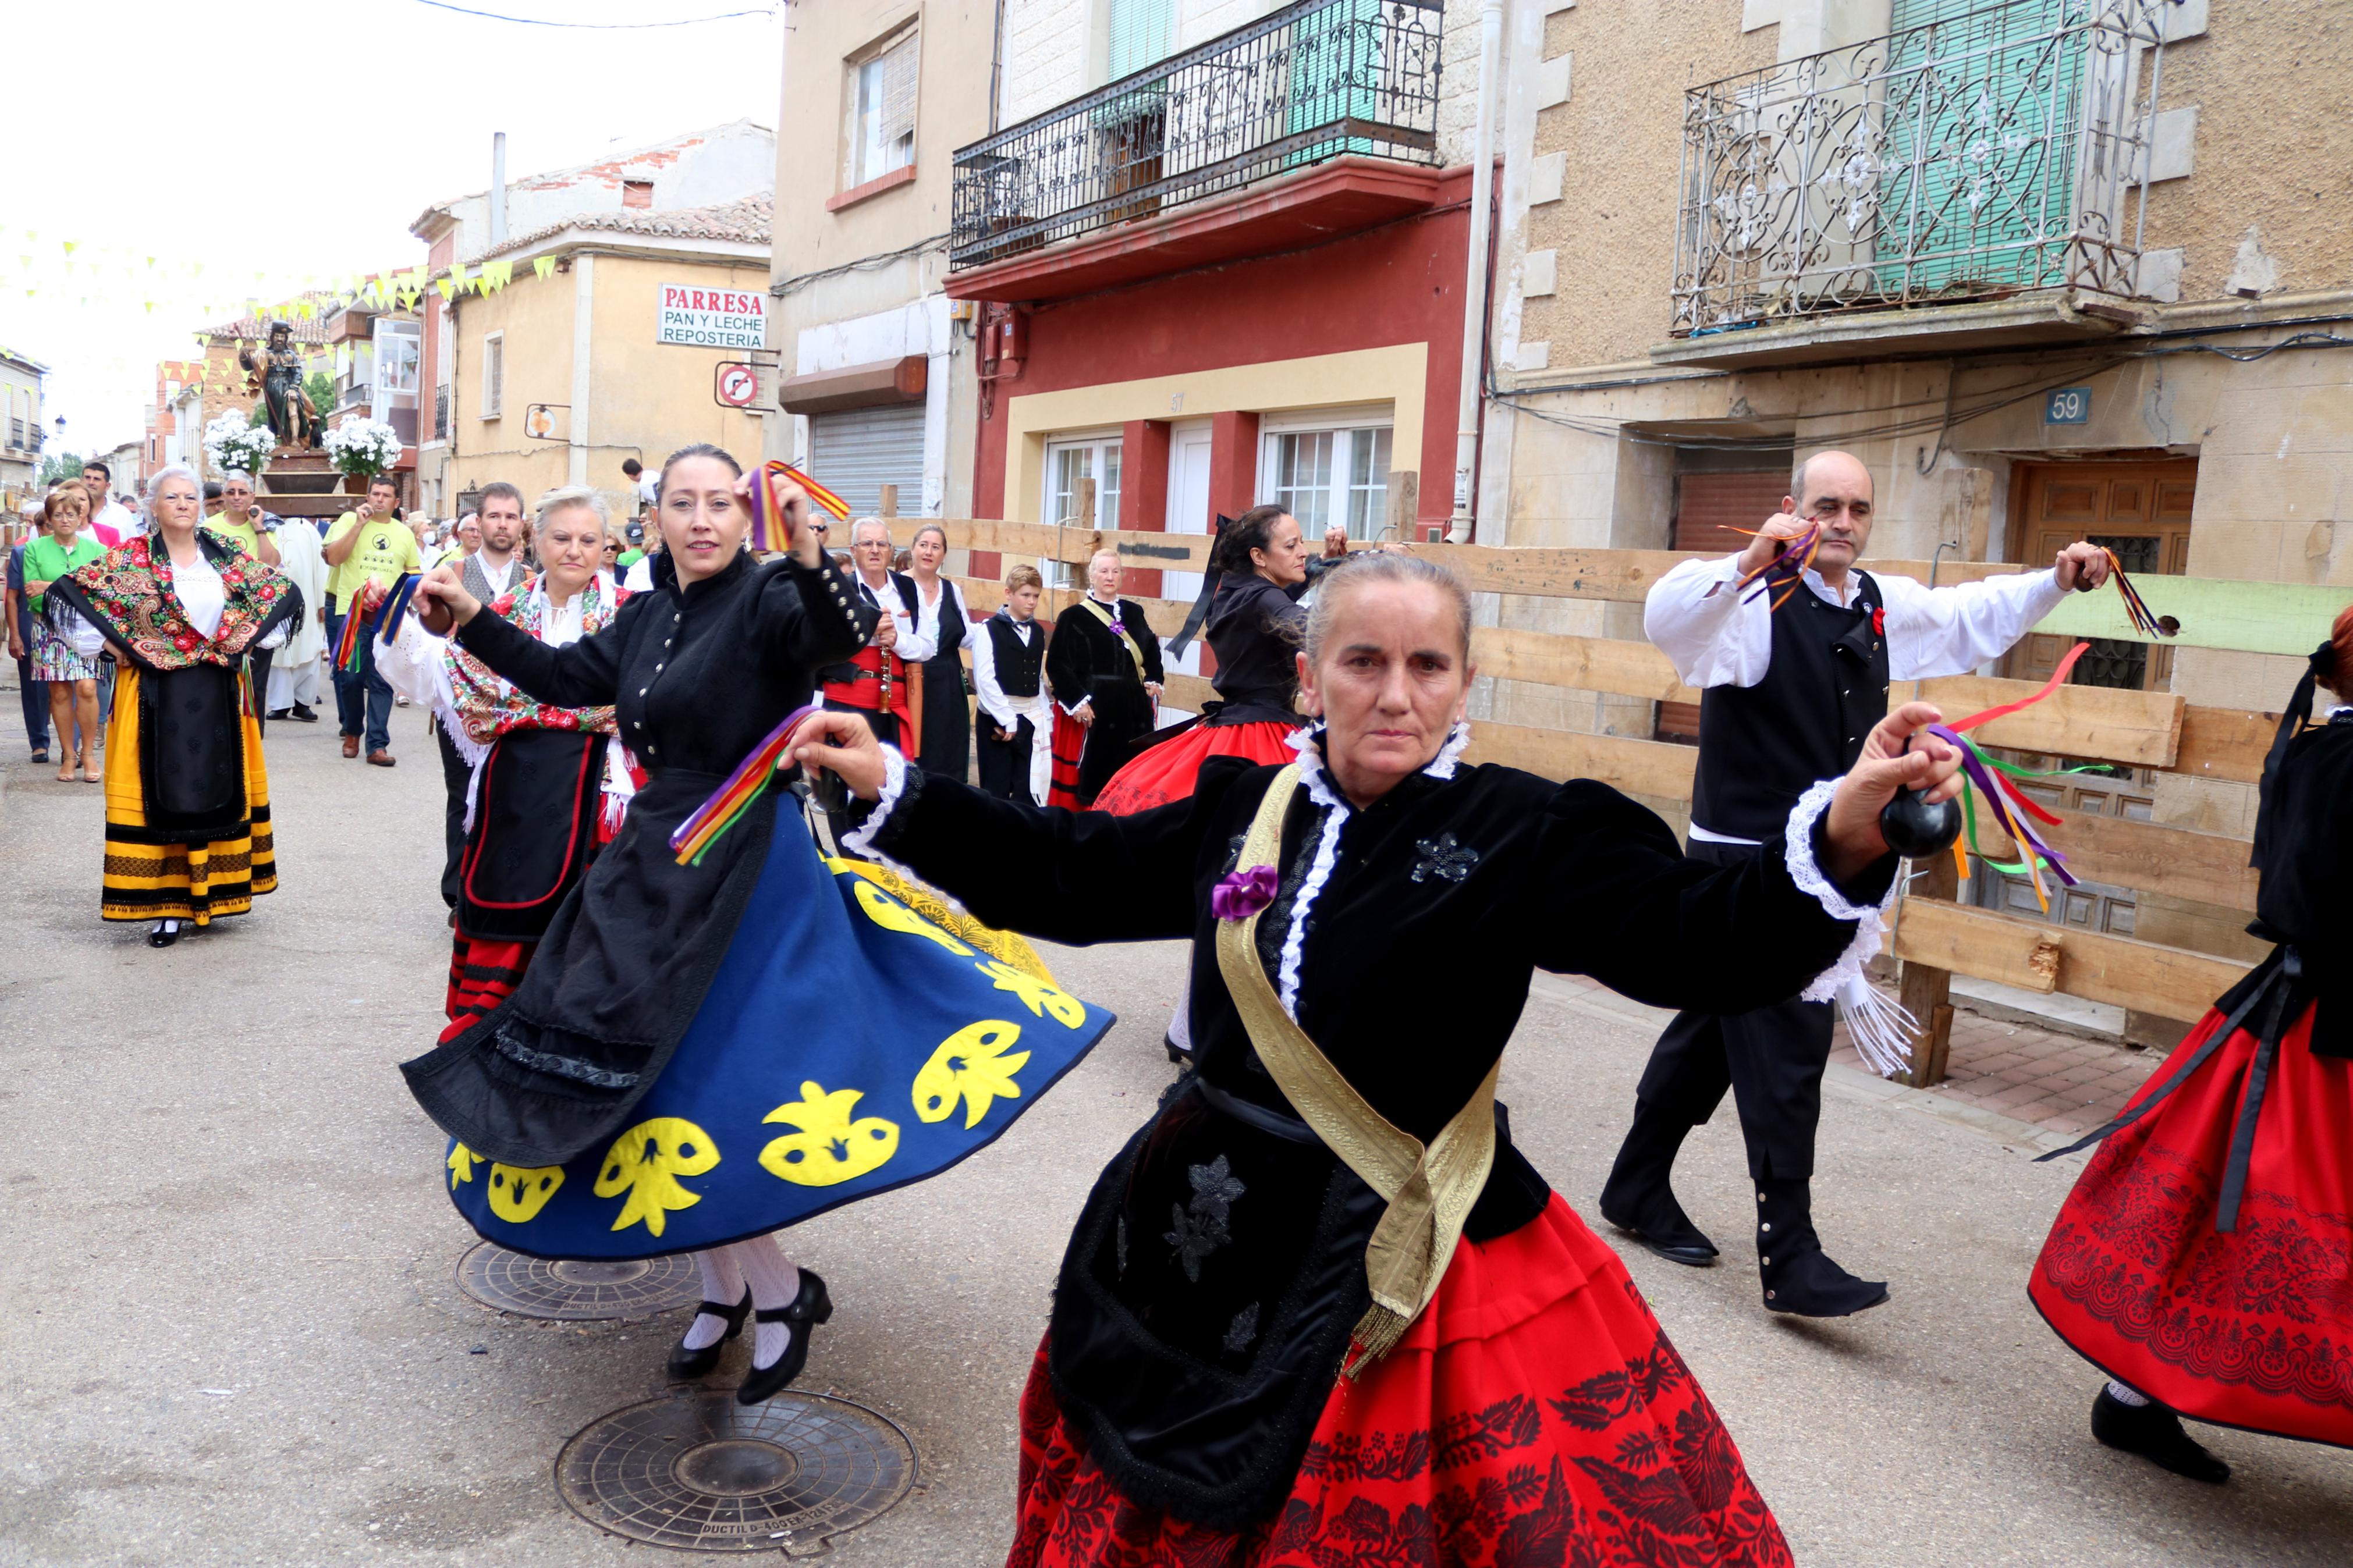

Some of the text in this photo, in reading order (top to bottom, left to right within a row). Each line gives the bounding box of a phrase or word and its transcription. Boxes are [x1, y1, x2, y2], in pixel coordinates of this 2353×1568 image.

[665, 288, 762, 315] PARRESA
[665, 311, 762, 331] PAN Y LECHE
[664, 328, 761, 347] REPOSTERIA
[1171, 392, 1183, 412] 57
[2053, 393, 2079, 419] 59
[702, 1524, 747, 1534] DUCTIL
